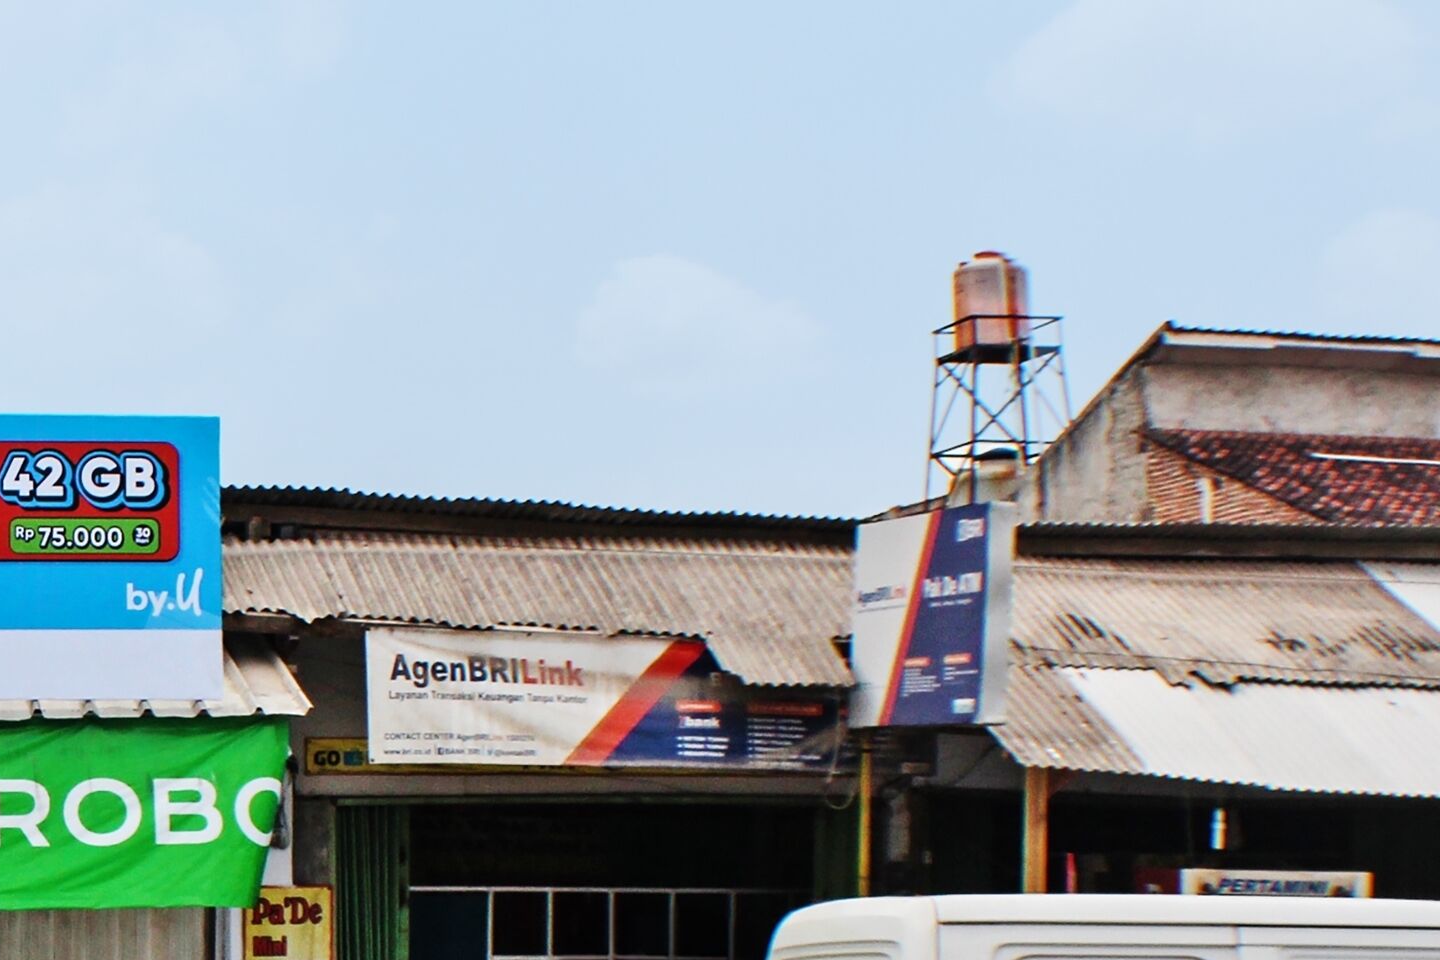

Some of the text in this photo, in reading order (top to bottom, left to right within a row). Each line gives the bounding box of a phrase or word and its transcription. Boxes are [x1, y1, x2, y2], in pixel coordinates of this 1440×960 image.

[2, 457, 157, 497] 42 GB
[15, 526, 123, 548] Rp 75.000
[135, 526, 151, 537] 30
[390, 653, 585, 688] AgenBRILink
[389, 690, 429, 702] Layanan
[384, 732, 422, 741] CONTACT
